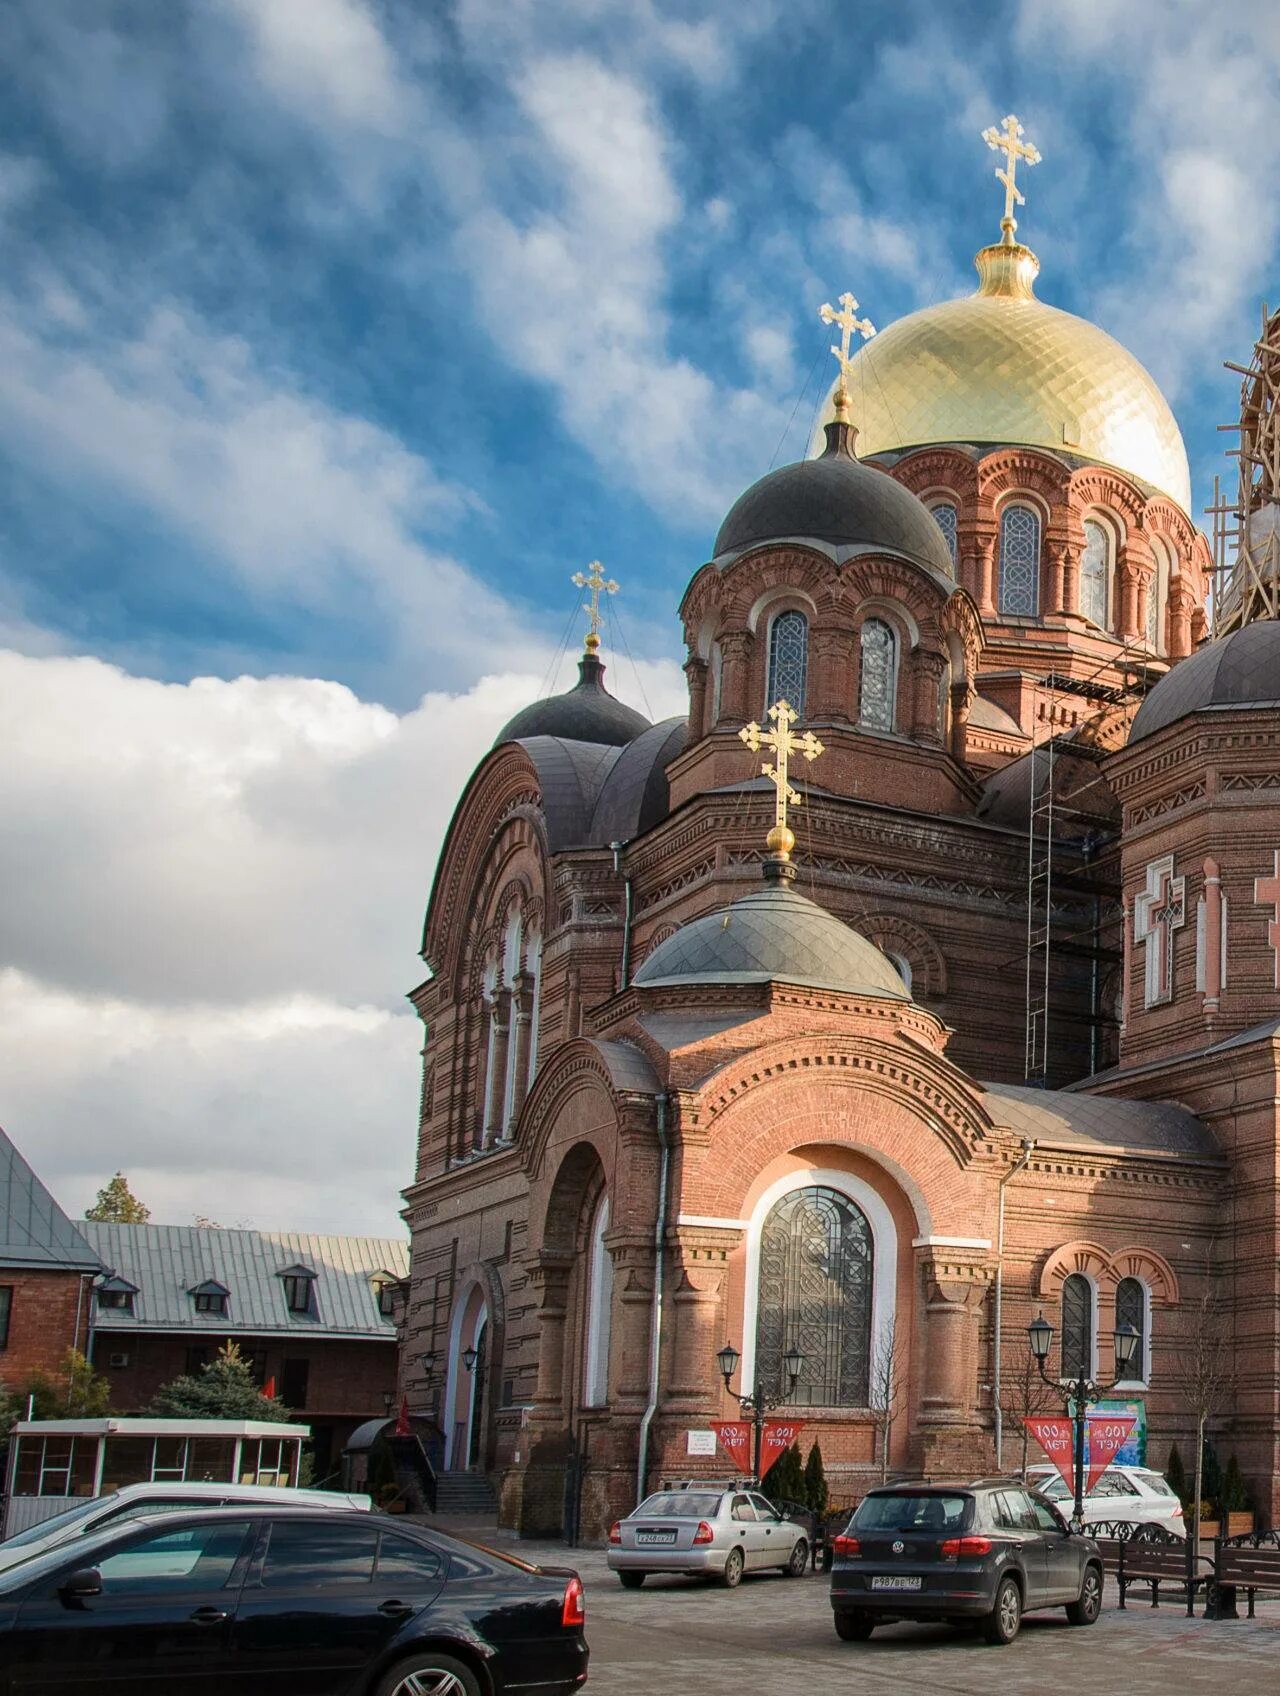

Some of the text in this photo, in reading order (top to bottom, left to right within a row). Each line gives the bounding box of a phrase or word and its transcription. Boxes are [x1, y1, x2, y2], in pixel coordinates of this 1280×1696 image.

[720, 1427, 738, 1437] 100
[1036, 1425, 1059, 1438] 100
[1044, 1440, 1068, 1450] ЛЕТ
